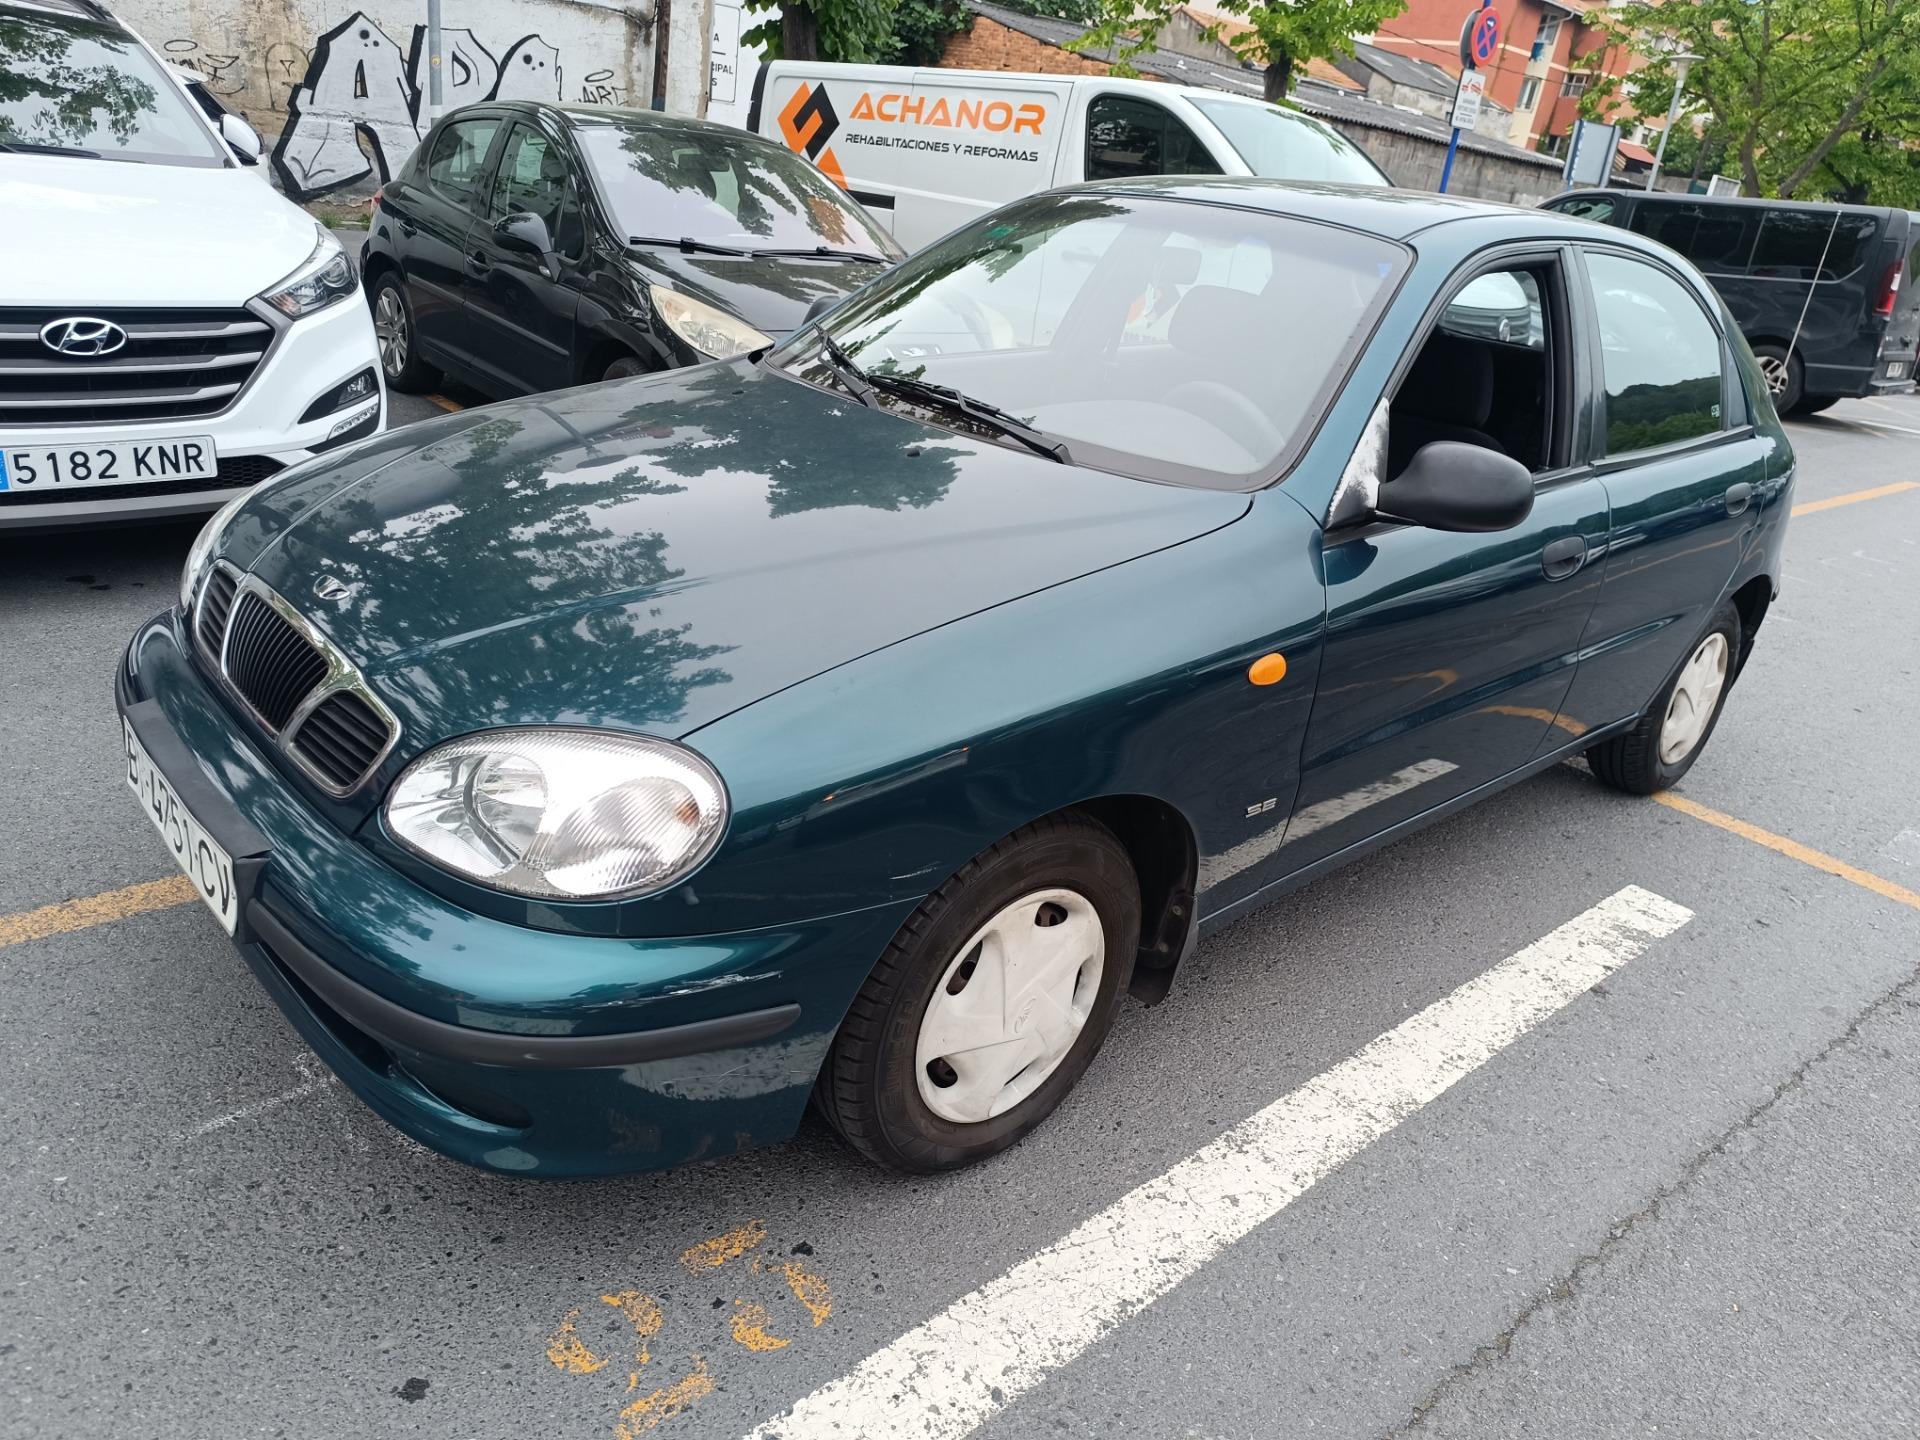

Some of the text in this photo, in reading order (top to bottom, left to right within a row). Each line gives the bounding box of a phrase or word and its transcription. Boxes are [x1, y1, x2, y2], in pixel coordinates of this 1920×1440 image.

[849, 92, 1046, 135] ACHANOR
[845, 133, 1039, 162] REHABILITACIONES Y REFORMAS
[13, 443, 206, 485] 5182 KNR
[1245, 797, 1278, 818] SE
